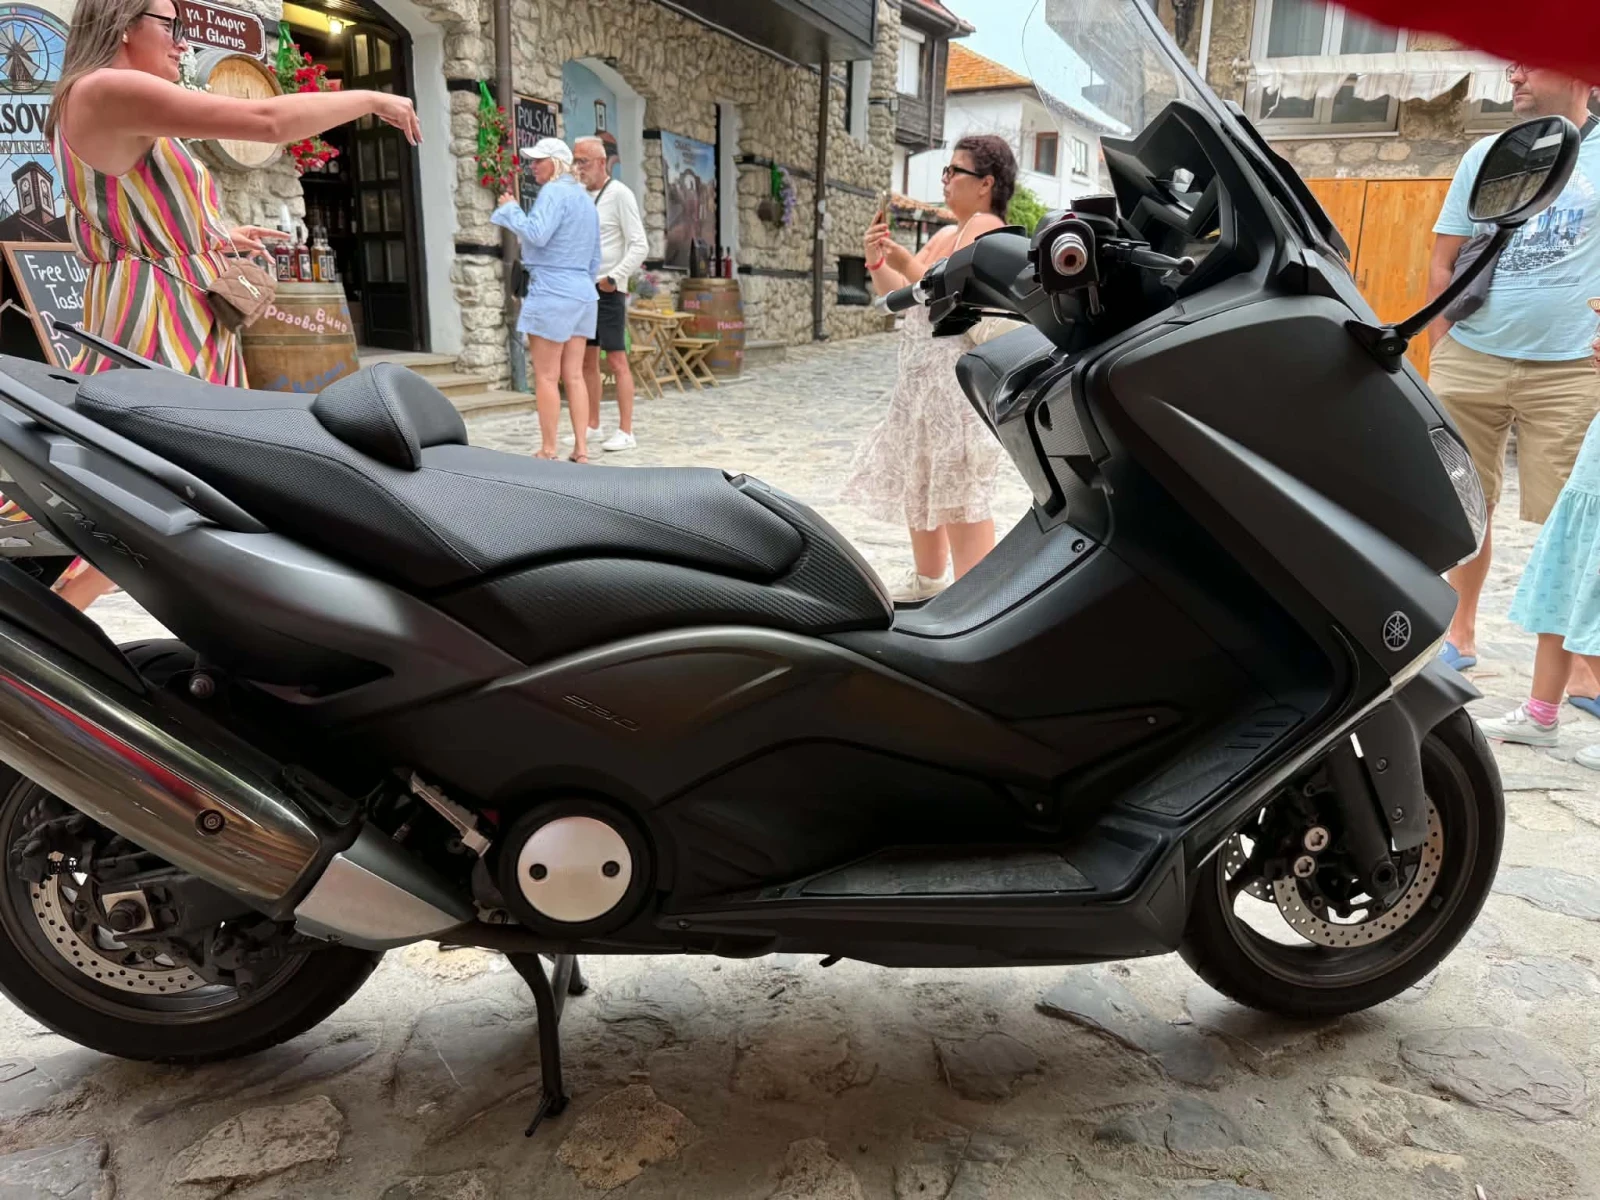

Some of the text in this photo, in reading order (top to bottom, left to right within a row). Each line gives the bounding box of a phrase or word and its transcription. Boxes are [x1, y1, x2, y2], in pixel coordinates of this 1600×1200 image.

[206, 9, 246, 35] Гларус
[189, 25, 246, 50] ul. Glarus
[0, 103, 51, 134] SOV
[517, 106, 556, 135] POLSKA
[24, 254, 66, 282] Free
[315, 307, 348, 333] Вино
